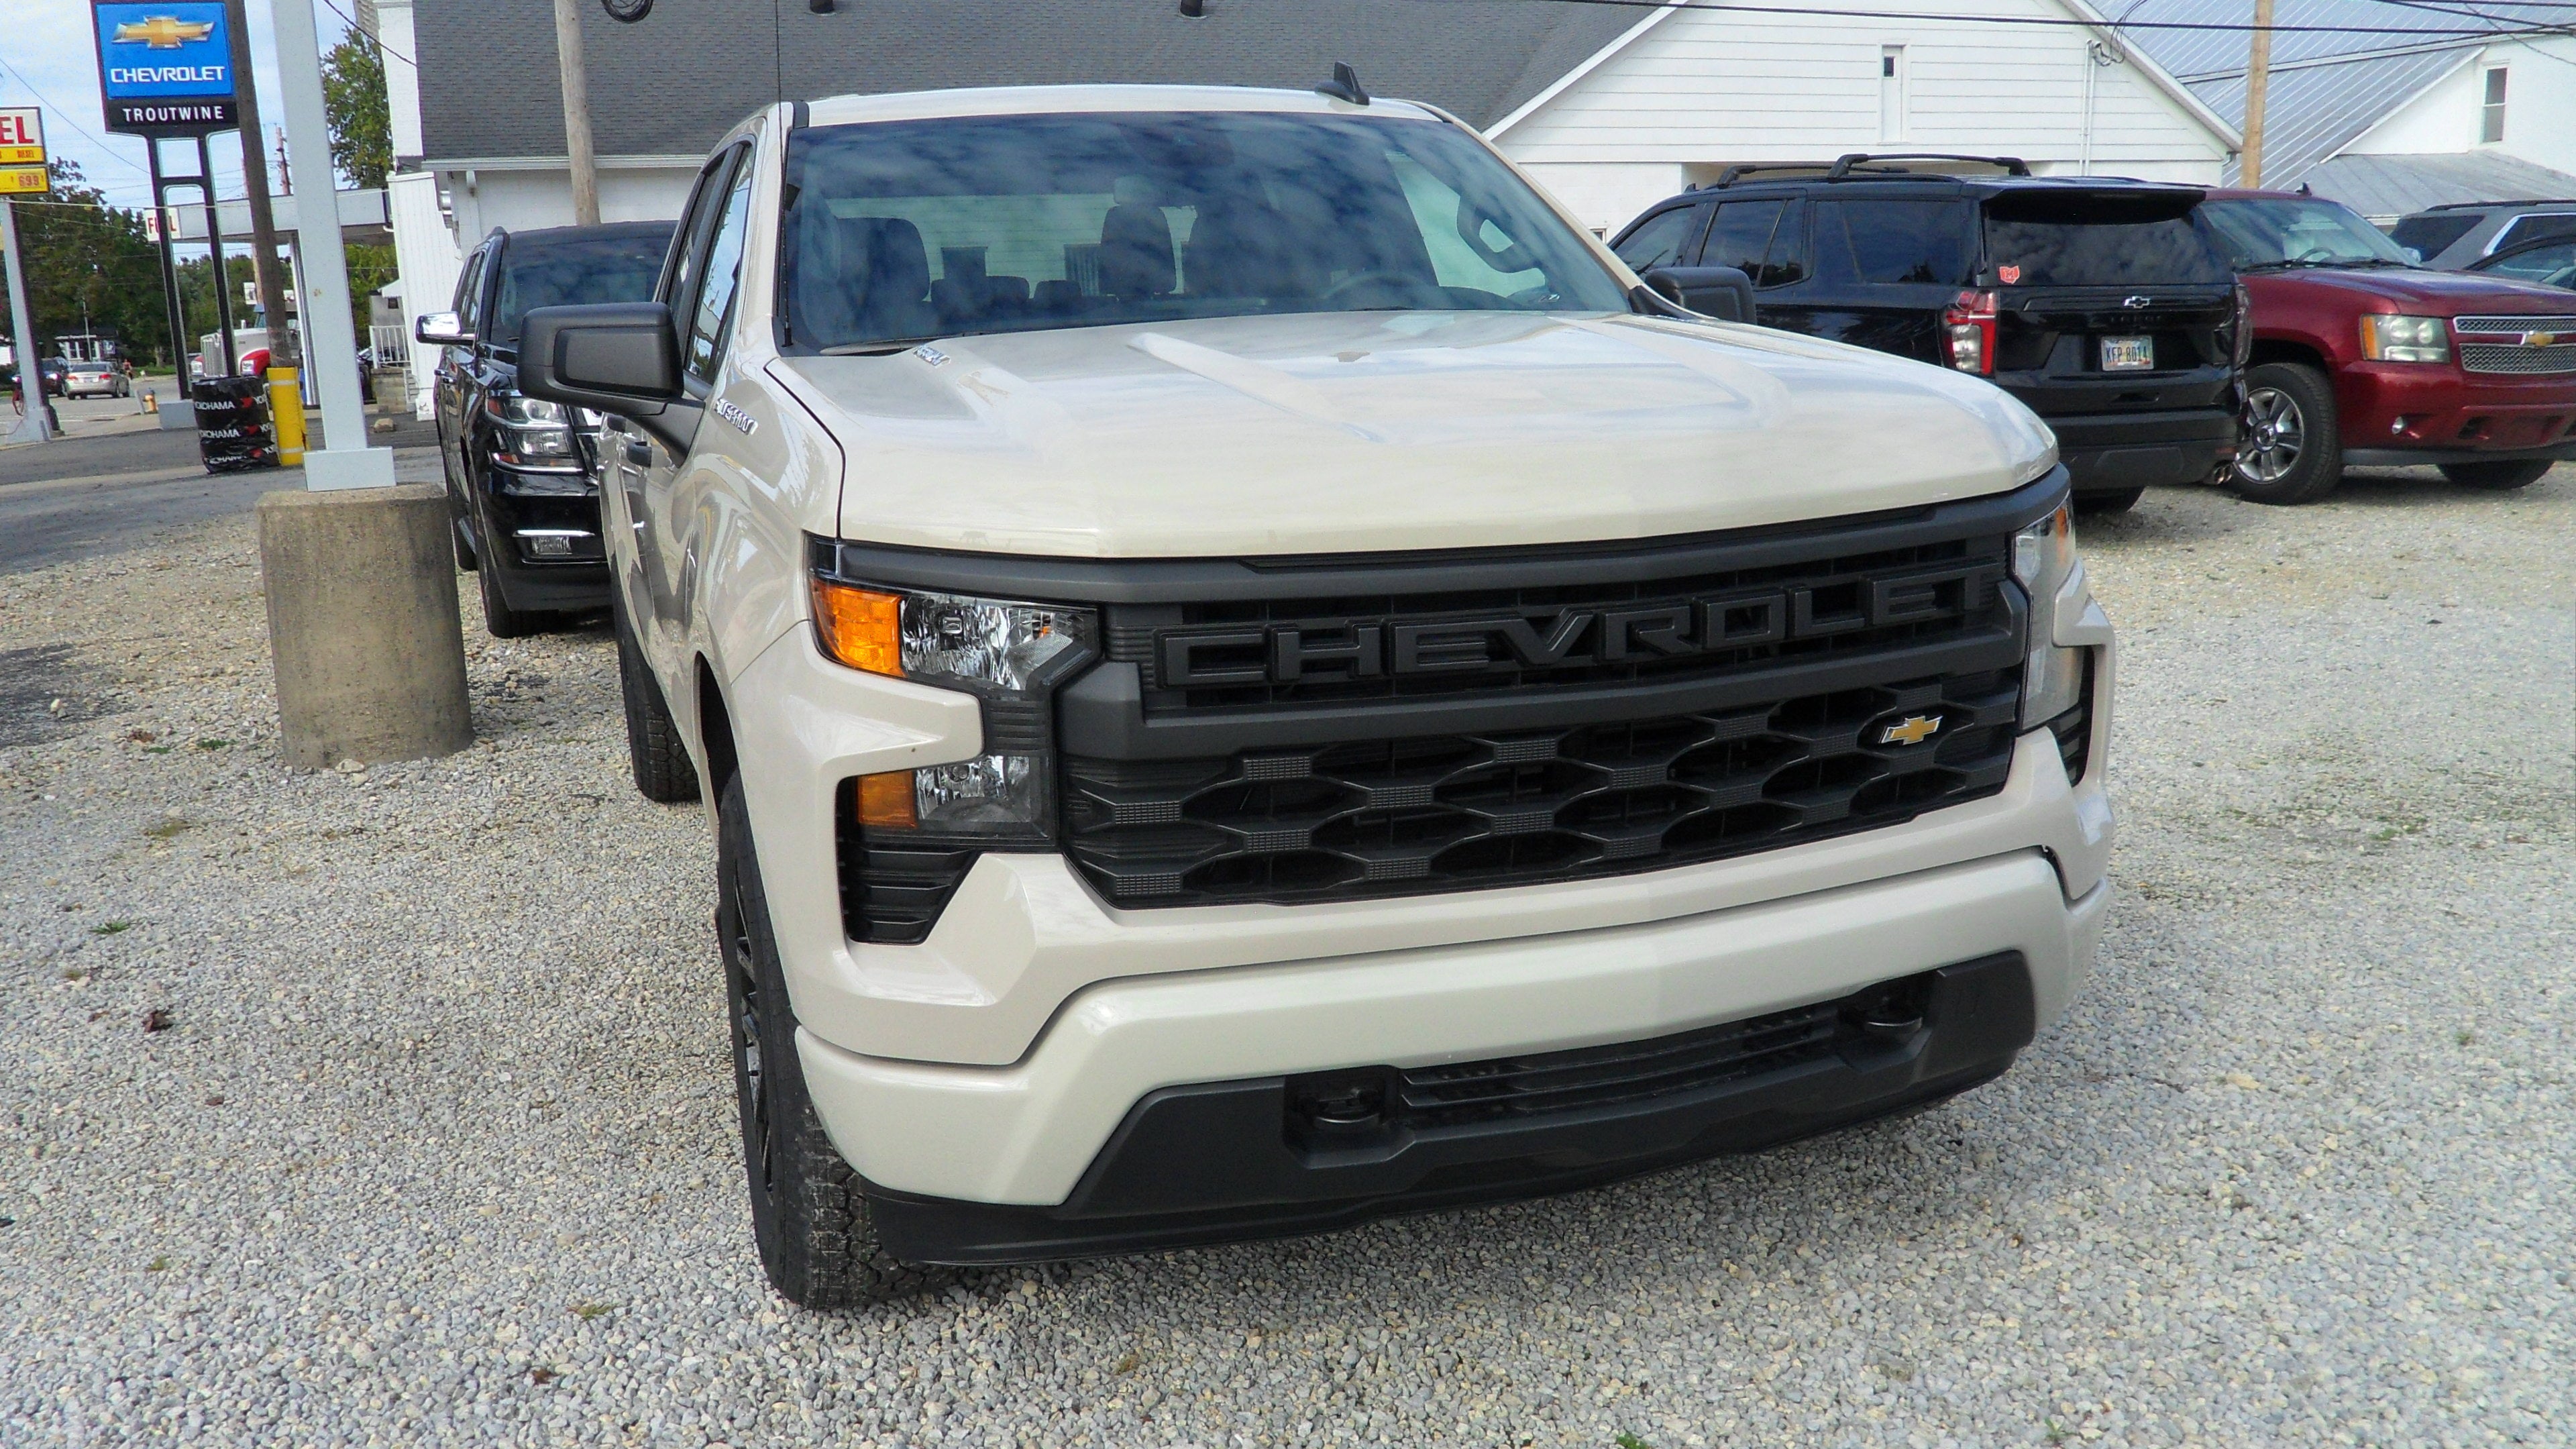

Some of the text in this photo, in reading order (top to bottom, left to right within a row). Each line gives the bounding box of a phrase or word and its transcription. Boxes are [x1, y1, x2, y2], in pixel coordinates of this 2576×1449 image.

[110, 66, 225, 83] CHEVROLET
[123, 106, 223, 122] TROUTWINE
[148, 215, 176, 234] FL
[1154, 559, 2002, 688] CHEVROLET
